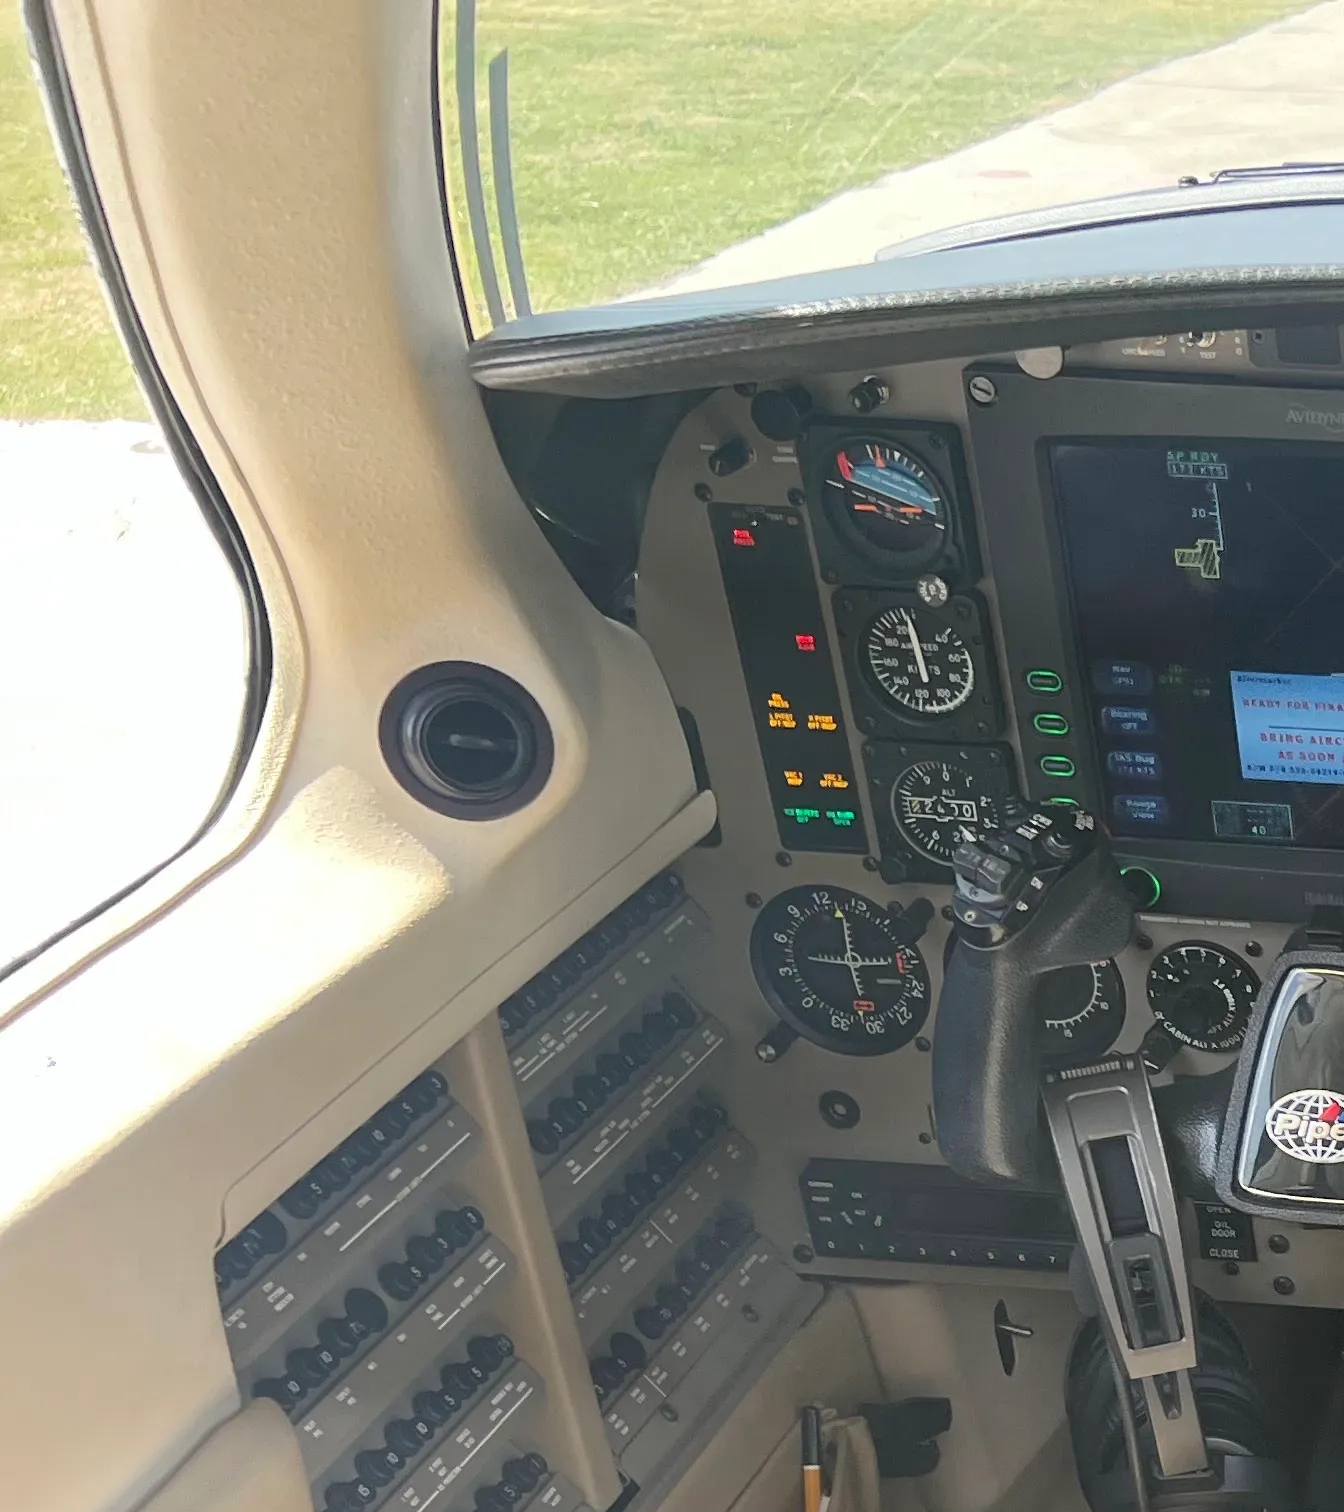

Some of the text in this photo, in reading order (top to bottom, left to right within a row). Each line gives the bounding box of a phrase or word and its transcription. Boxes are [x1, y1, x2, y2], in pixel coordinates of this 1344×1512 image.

[1243, 699, 1280, 709] READY
[1288, 701, 1308, 710] FOR
[1260, 733, 1303, 744] BRING
[1278, 750, 1293, 760] AS
[1299, 751, 1335, 762] SOON
[1214, 1220, 1231, 1229] OIL
[1211, 1228, 1236, 1238] DOOR
[1209, 1248, 1239, 1258] CLOSE
